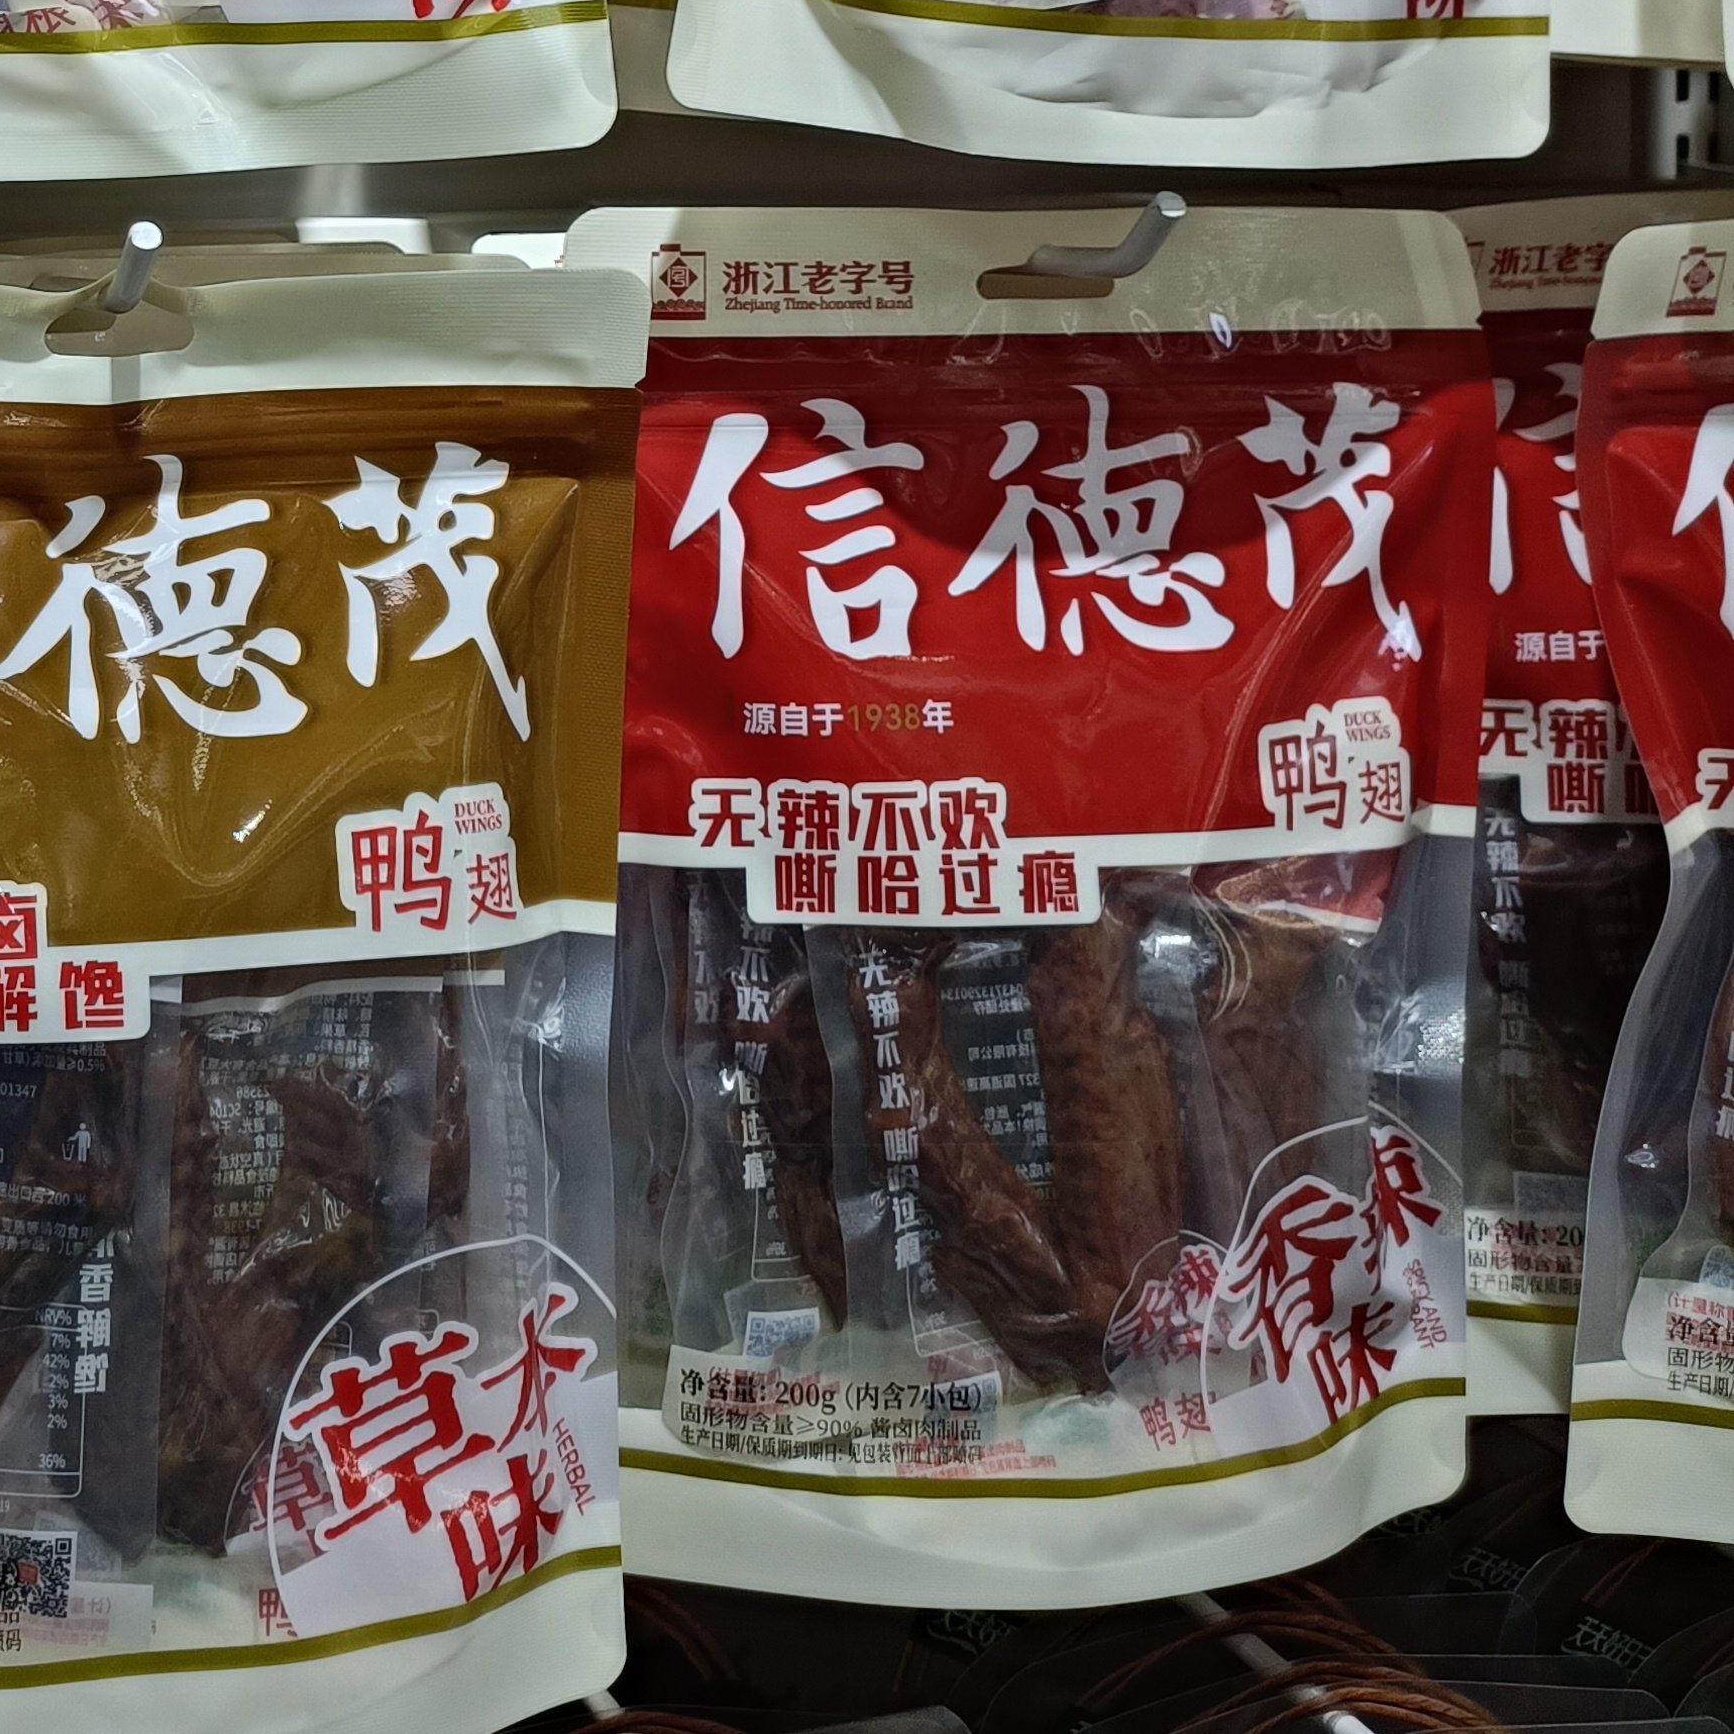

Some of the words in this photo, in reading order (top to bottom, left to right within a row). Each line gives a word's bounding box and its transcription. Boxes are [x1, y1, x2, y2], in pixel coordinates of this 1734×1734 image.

[722, 261, 915, 295] 浙江老字号
[725, 297, 780, 313] Zhejiang
[785, 297, 872, 311] Time-honored
[876, 297, 914, 311] Brand
[669, 382, 1421, 662] 信德茂
[1516, 630, 1604, 662] 源自于
[744, 699, 955, 737] 源自于1938年
[1343, 711, 1382, 727] DUCK
[1345, 725, 1391, 743] WINGS
[1270, 721, 1404, 831] 鸭翅
[454, 798, 495, 817] DUCK
[700, 788, 1000, 850] 无辣不欢
[456, 815, 503, 835] WINGS
[352, 809, 517, 932] 鸭翅
[775, 850, 1080, 915] 嘶哈过瘾
[1423, 1307, 1447, 1342] AND
[51, 1333, 71, 1349] 7%
[42, 1354, 70, 1369] 42%
[49, 1375, 69, 1390] 2%
[47, 1395, 68, 1410] 3%
[47, 1414, 67, 1430] 2%
[680, 1402, 863, 1438] 固形物含量≥90%
[870, 1417, 982, 1442] 酱卤肉制品
[38, 1453, 66, 1469] 36%
[290, 1294, 587, 1602] 草本味
[552, 1417, 596, 1516] HERBAL
